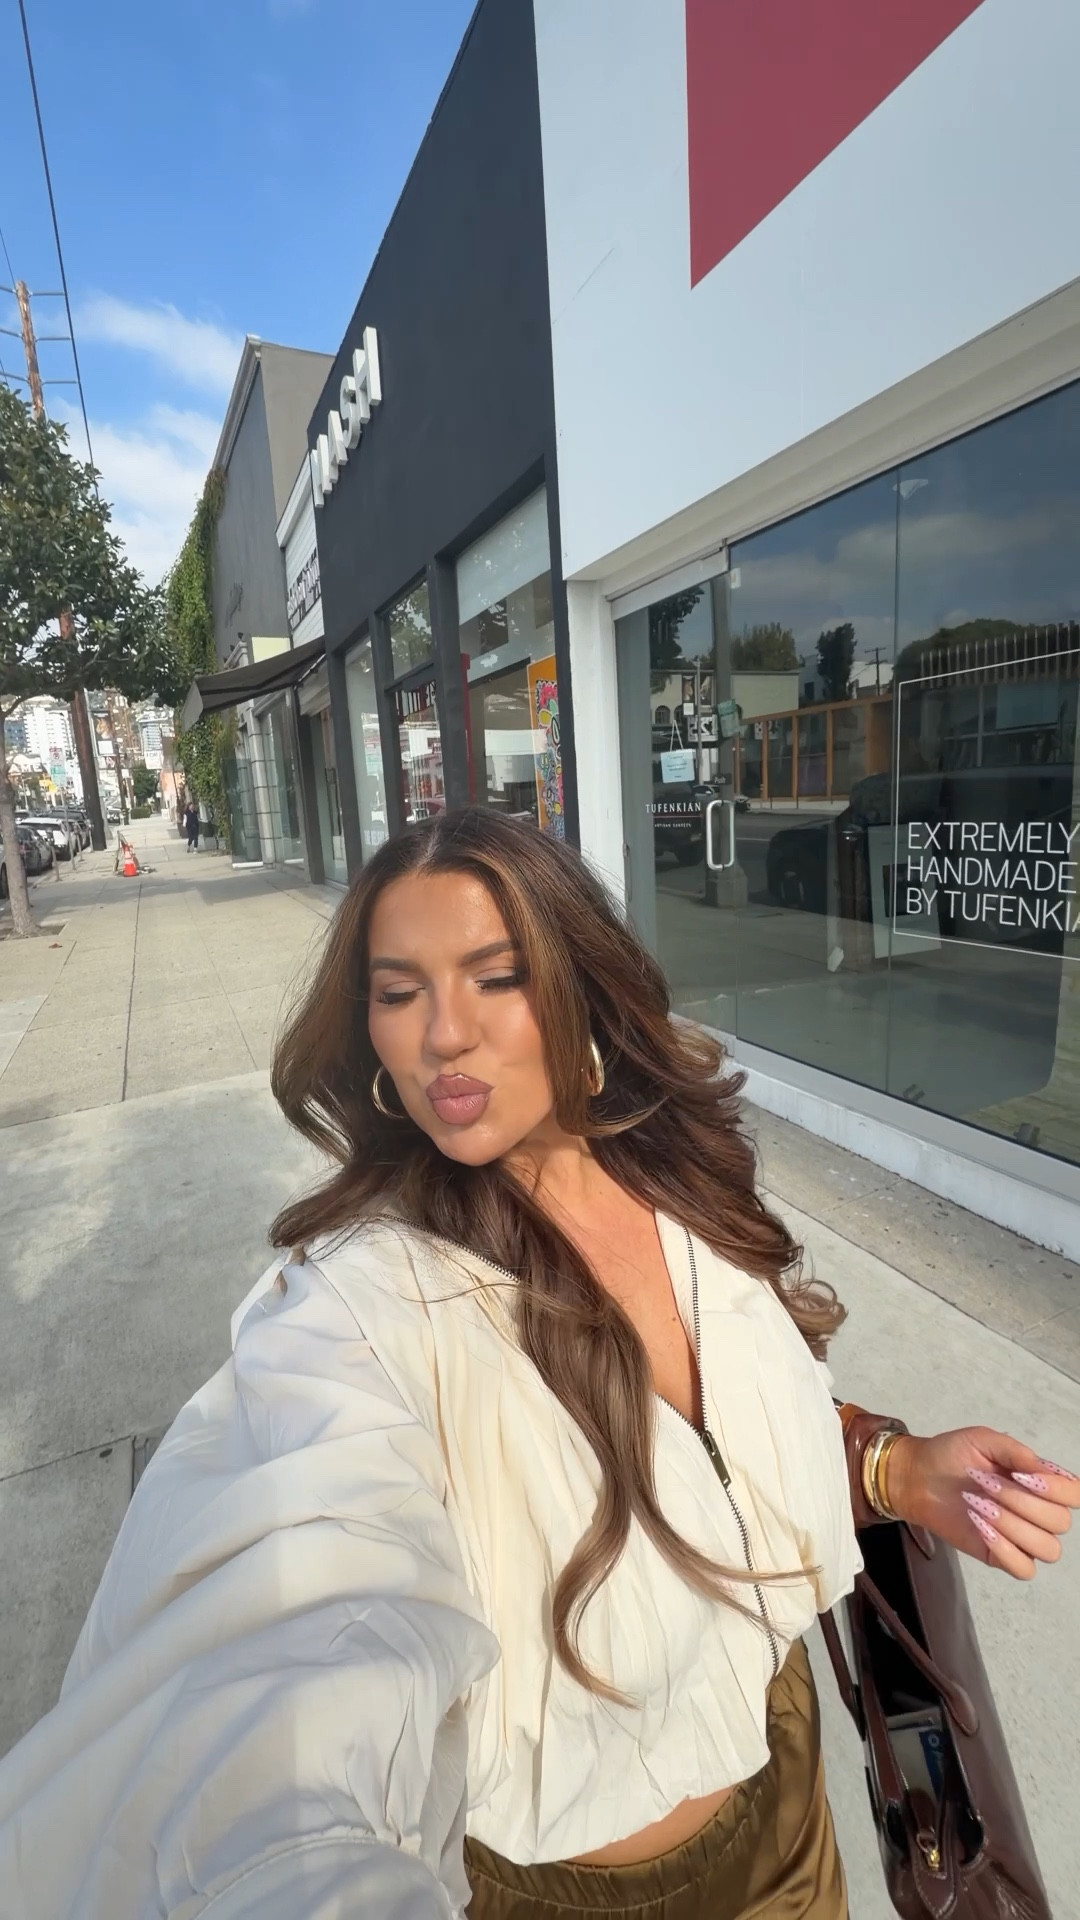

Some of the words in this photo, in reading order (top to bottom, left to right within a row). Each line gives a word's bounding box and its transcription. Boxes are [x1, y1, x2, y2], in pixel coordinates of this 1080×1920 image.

[645, 802, 701, 813] TUFENKIAN
[908, 822, 1080, 854] EXTREMELY
[907, 855, 1078, 894] HANDMADE
[906, 887, 938, 915] BY
